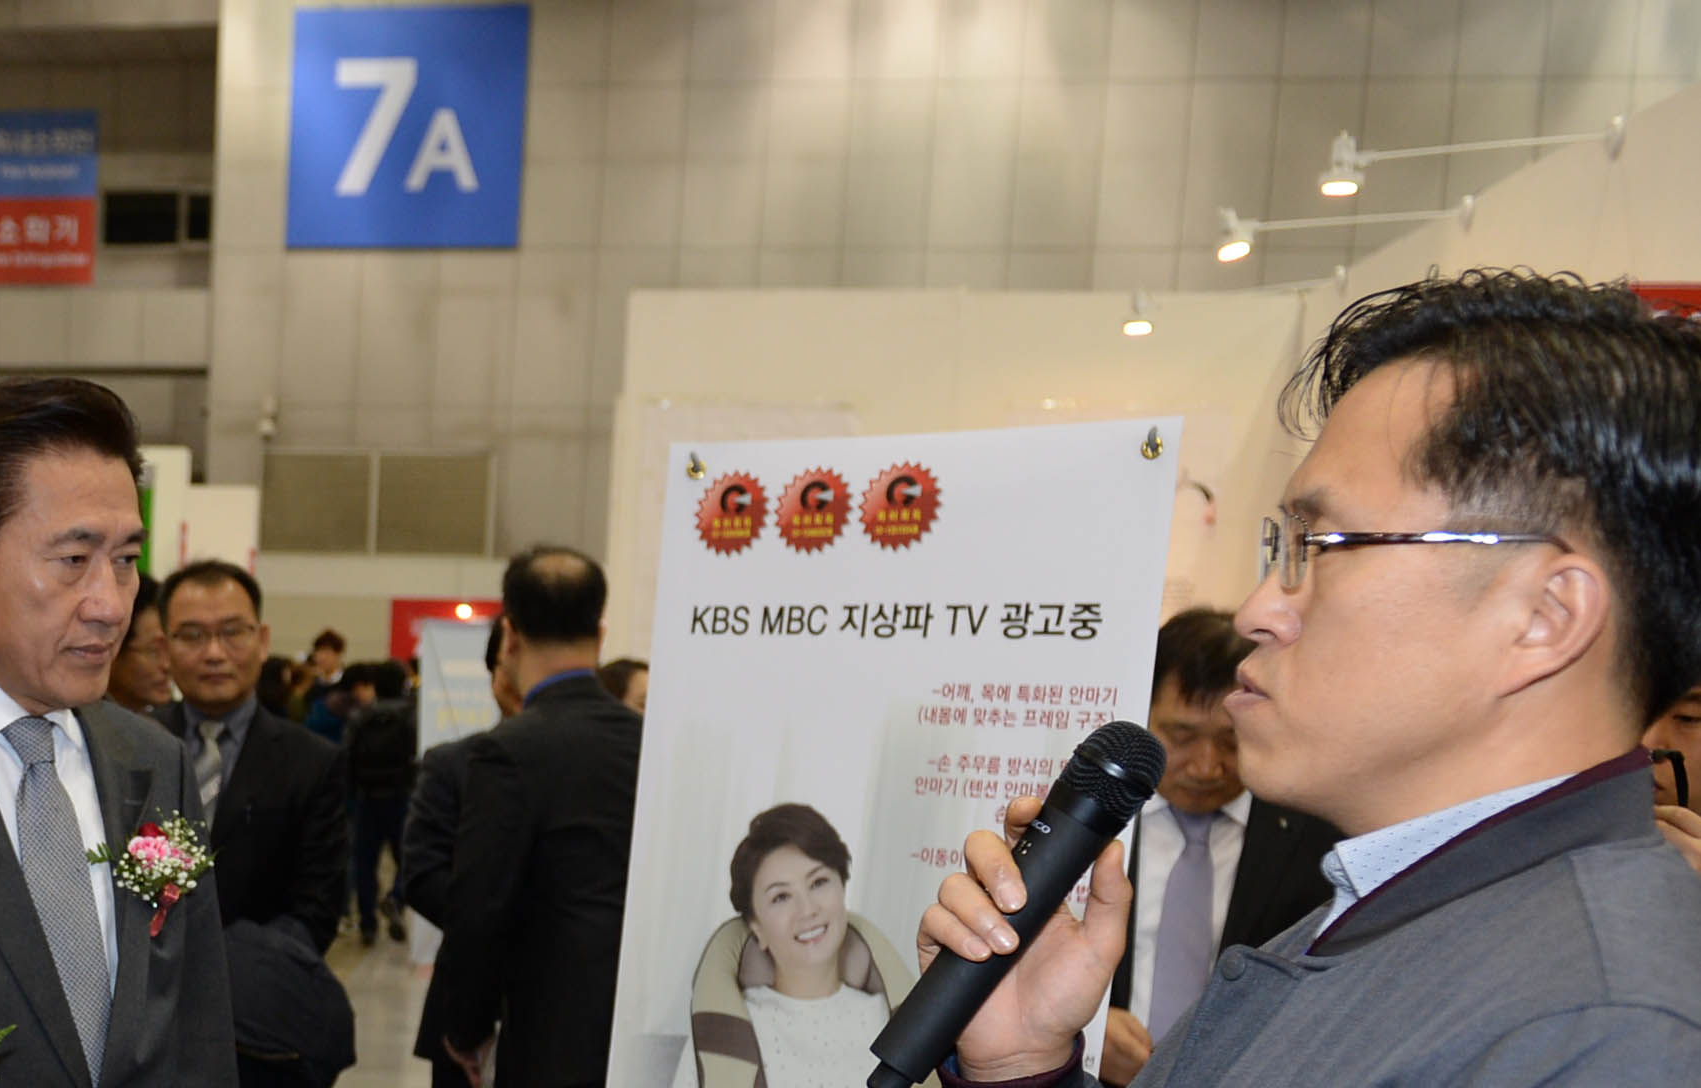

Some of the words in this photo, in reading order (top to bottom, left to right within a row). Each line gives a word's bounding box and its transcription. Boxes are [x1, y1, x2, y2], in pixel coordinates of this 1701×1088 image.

[690, 605, 749, 636] KBS
[760, 605, 828, 636] MBC
[839, 603, 934, 638] 지상파
[946, 605, 989, 636] TV
[1000, 602, 1103, 640] 광고중
[981, 684, 1012, 702] 목에
[1018, 684, 1063, 705] 특화된
[1069, 686, 1118, 707] 안마기
[973, 706, 1018, 727] 맞추는
[1023, 708, 1071, 729] 프레임
[1007, 757, 1053, 777] 방식의
[914, 776, 958, 796] 안마기
